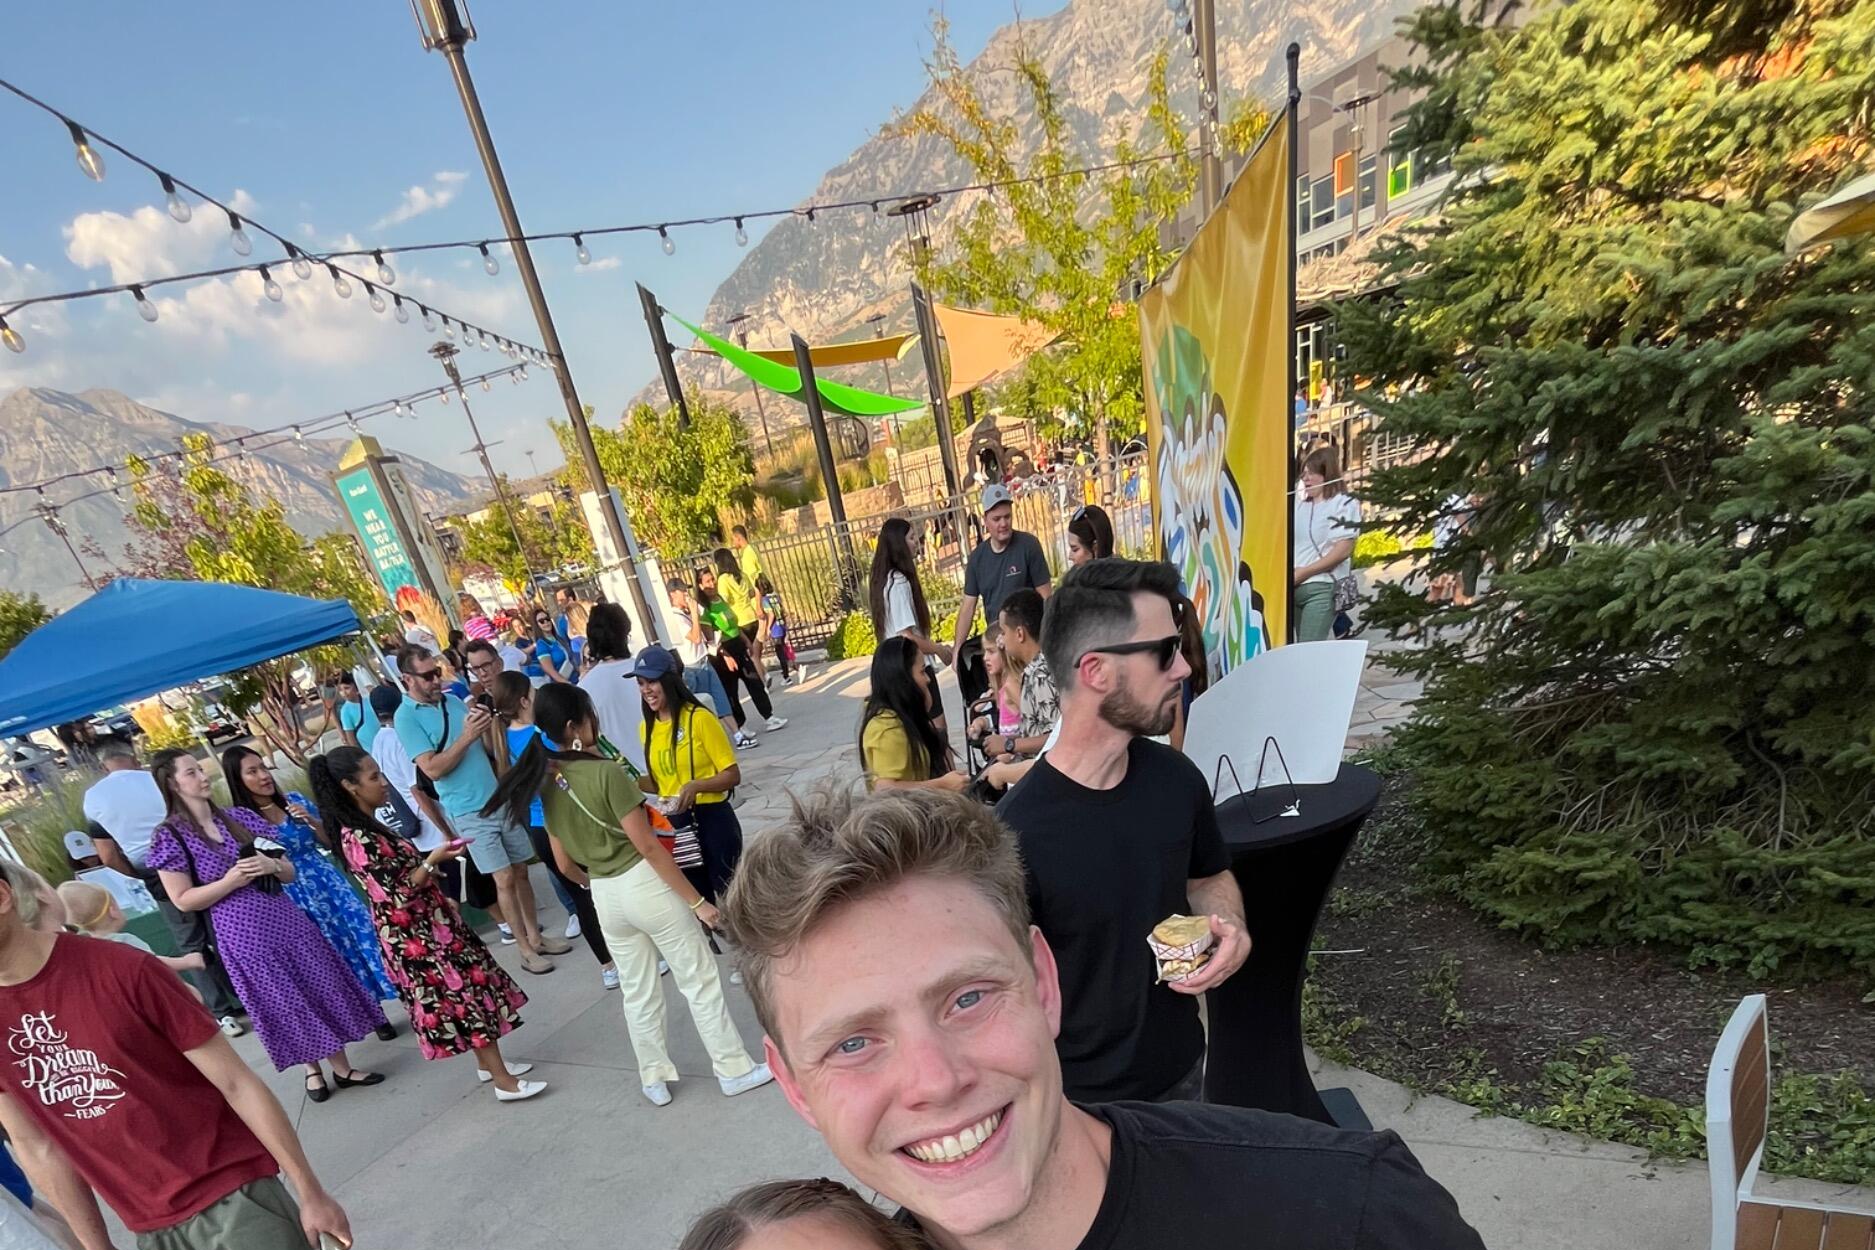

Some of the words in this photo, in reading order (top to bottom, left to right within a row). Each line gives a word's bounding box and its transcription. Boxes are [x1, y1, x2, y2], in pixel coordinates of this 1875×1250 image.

[9, 1010, 68, 1050] Let
[12, 1049, 108, 1088] Dream
[38, 1079, 83, 1105] than
[76, 1105, 106, 1119] FEARS
